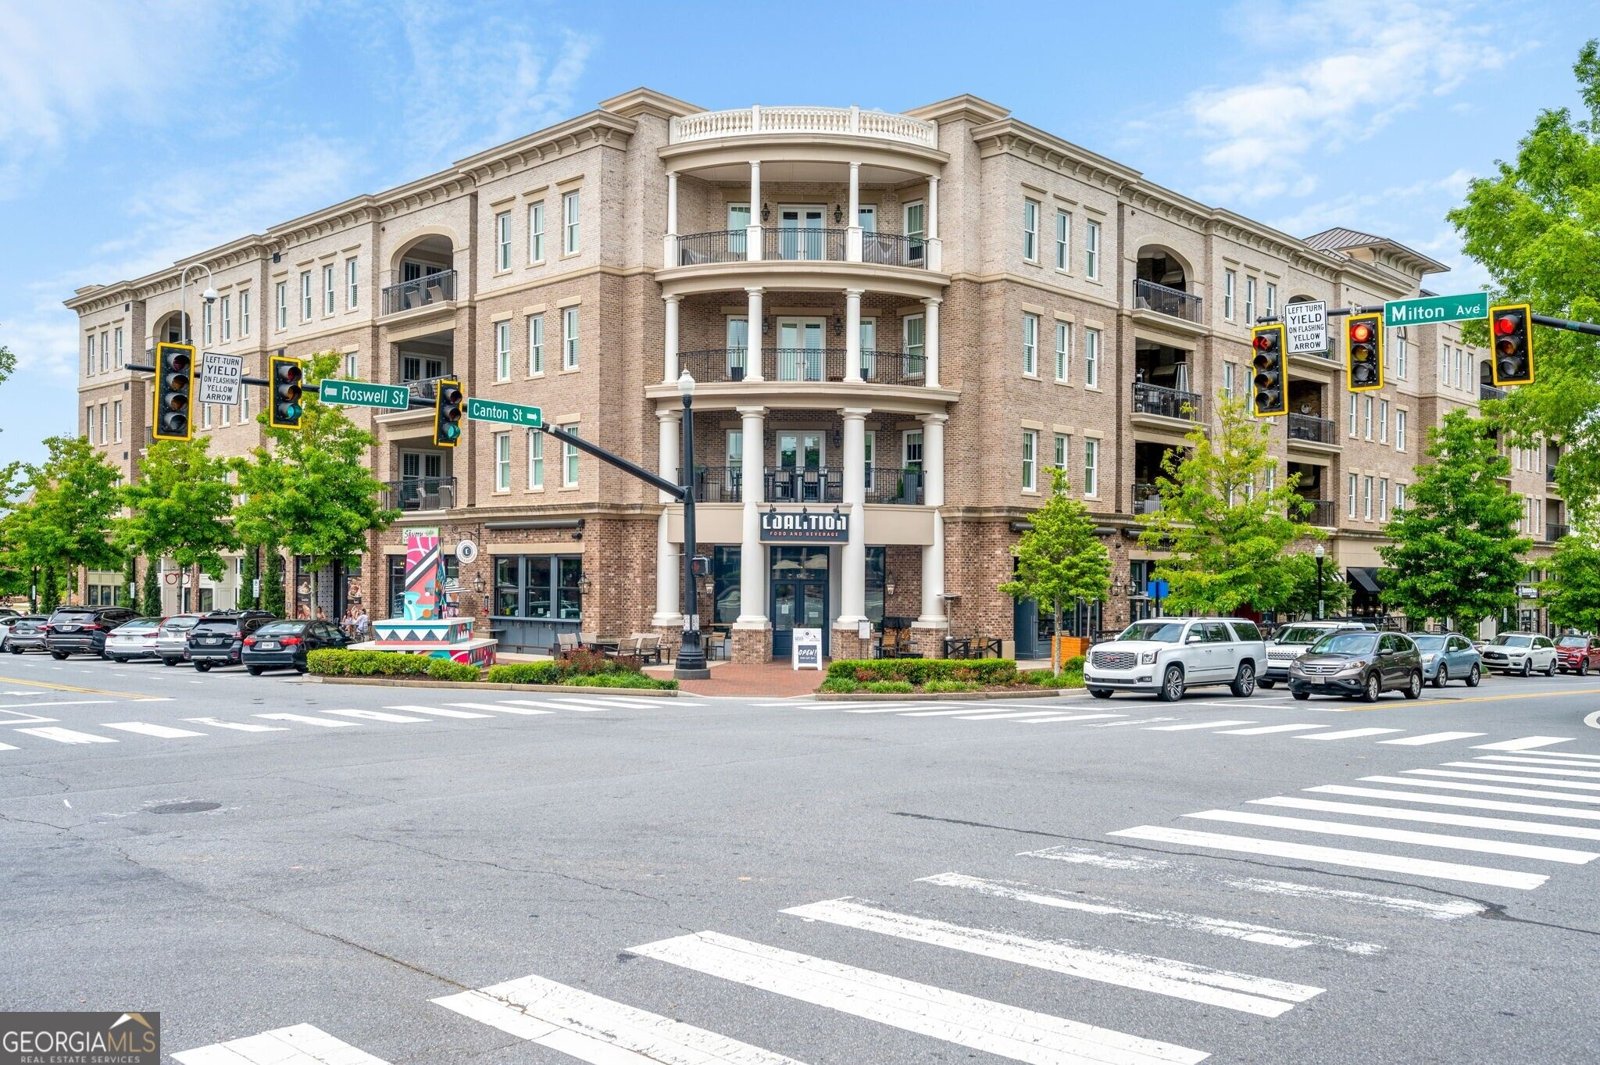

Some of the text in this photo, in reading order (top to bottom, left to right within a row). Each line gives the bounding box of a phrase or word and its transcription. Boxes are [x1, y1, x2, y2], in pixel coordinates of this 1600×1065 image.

[1288, 304, 1322, 314] LEFT TURN
[1391, 304, 1480, 322] Milton Ave
[1290, 313, 1322, 324] YIELD
[1298, 324, 1324, 333] FLASHING
[1294, 333, 1320, 341] YELLOW
[1295, 341, 1321, 350] ARROW
[223, 358, 240, 366] TURN
[207, 365, 238, 377] YIELD
[213, 376, 238, 386] FLASHING
[207, 384, 233, 393] YELLOW
[206, 393, 232, 401] ARROW
[341, 387, 404, 405] Roswell St
[473, 403, 523, 422] Canton St
